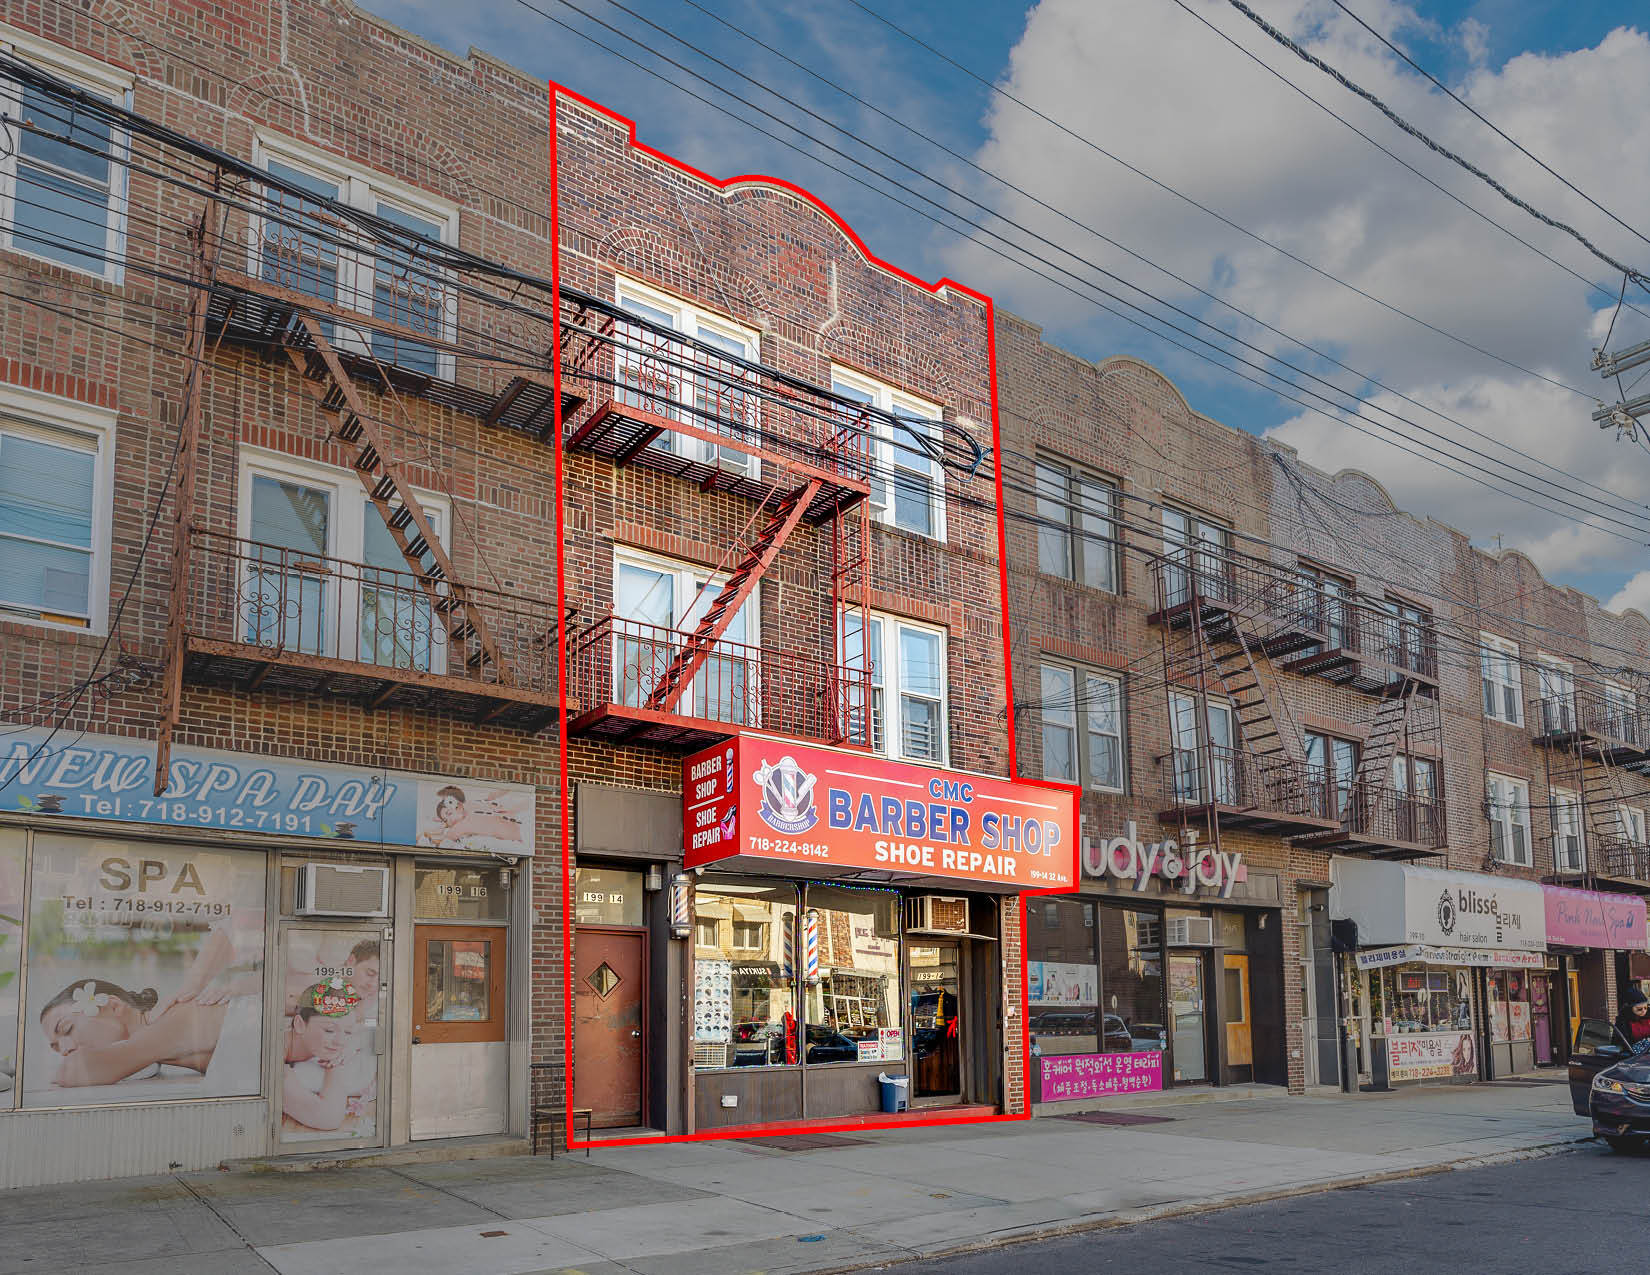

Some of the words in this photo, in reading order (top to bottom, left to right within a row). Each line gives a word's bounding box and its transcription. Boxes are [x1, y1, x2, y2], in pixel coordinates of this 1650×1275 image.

[691, 755, 722, 781] BARBER
[0, 744, 147, 793] NEW
[162, 761, 278, 809] SPA
[289, 775, 397, 819] DAY
[696, 778, 717, 800] SHOP
[929, 777, 974, 804] CMC
[139, 799, 311, 832] 718-912-7191
[696, 806, 717, 828] SHOE
[767, 814, 810, 831] BARBERSHOP
[828, 788, 970, 846] BARBER
[981, 812, 1061, 857] SHOP
[692, 826, 720, 849] REPAIR
[749, 836, 829, 858] 718-224-8142
[874, 841, 936, 868] SHOE
[942, 848, 1016, 876] REPAIR
[100, 857, 206, 896] SPA
[440, 885, 461, 895] 199
[473, 887, 486, 896] 16
[586, 893, 603, 902] 199
[612, 895, 622, 903] 14
[113, 898, 231, 916] 718-912-7191
[1459, 889, 1498, 915] blissé
[1460, 931, 1471, 942] hair
[1472, 933, 1487, 944] salon
[315, 967, 353, 976] 199-16
[887, 1030, 900, 1038] OPEN
[1043, 1059, 1072, 1080] 홈케어
[1134, 1054, 1160, 1069] 테라피
